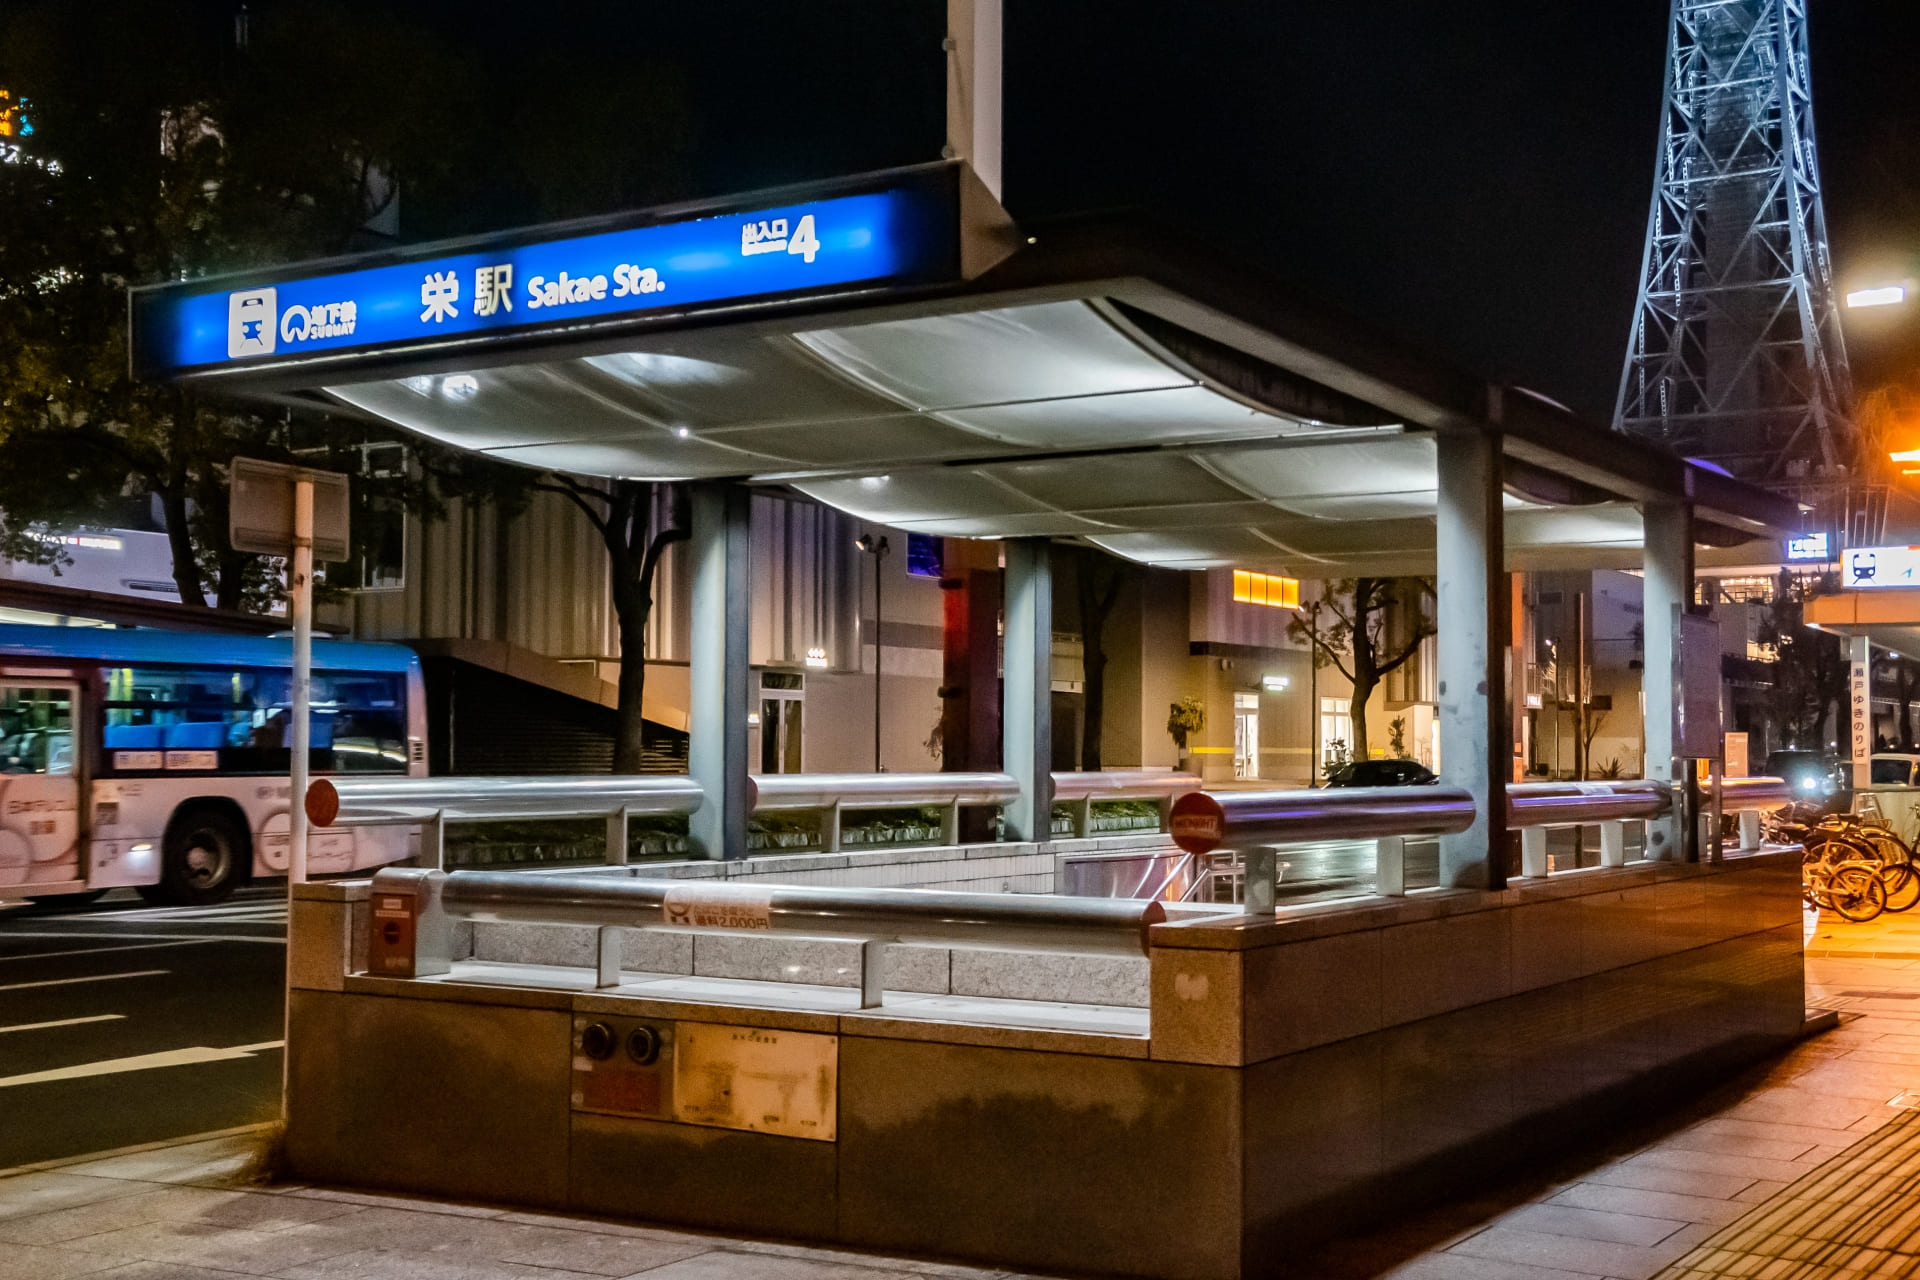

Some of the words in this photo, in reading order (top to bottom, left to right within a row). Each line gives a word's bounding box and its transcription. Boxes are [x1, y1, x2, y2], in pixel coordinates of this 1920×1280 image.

[787, 214, 820, 263] 4
[527, 272, 608, 309] Sakae
[613, 263, 665, 297] Sta.
[310, 322, 356, 340] SUBWAY
